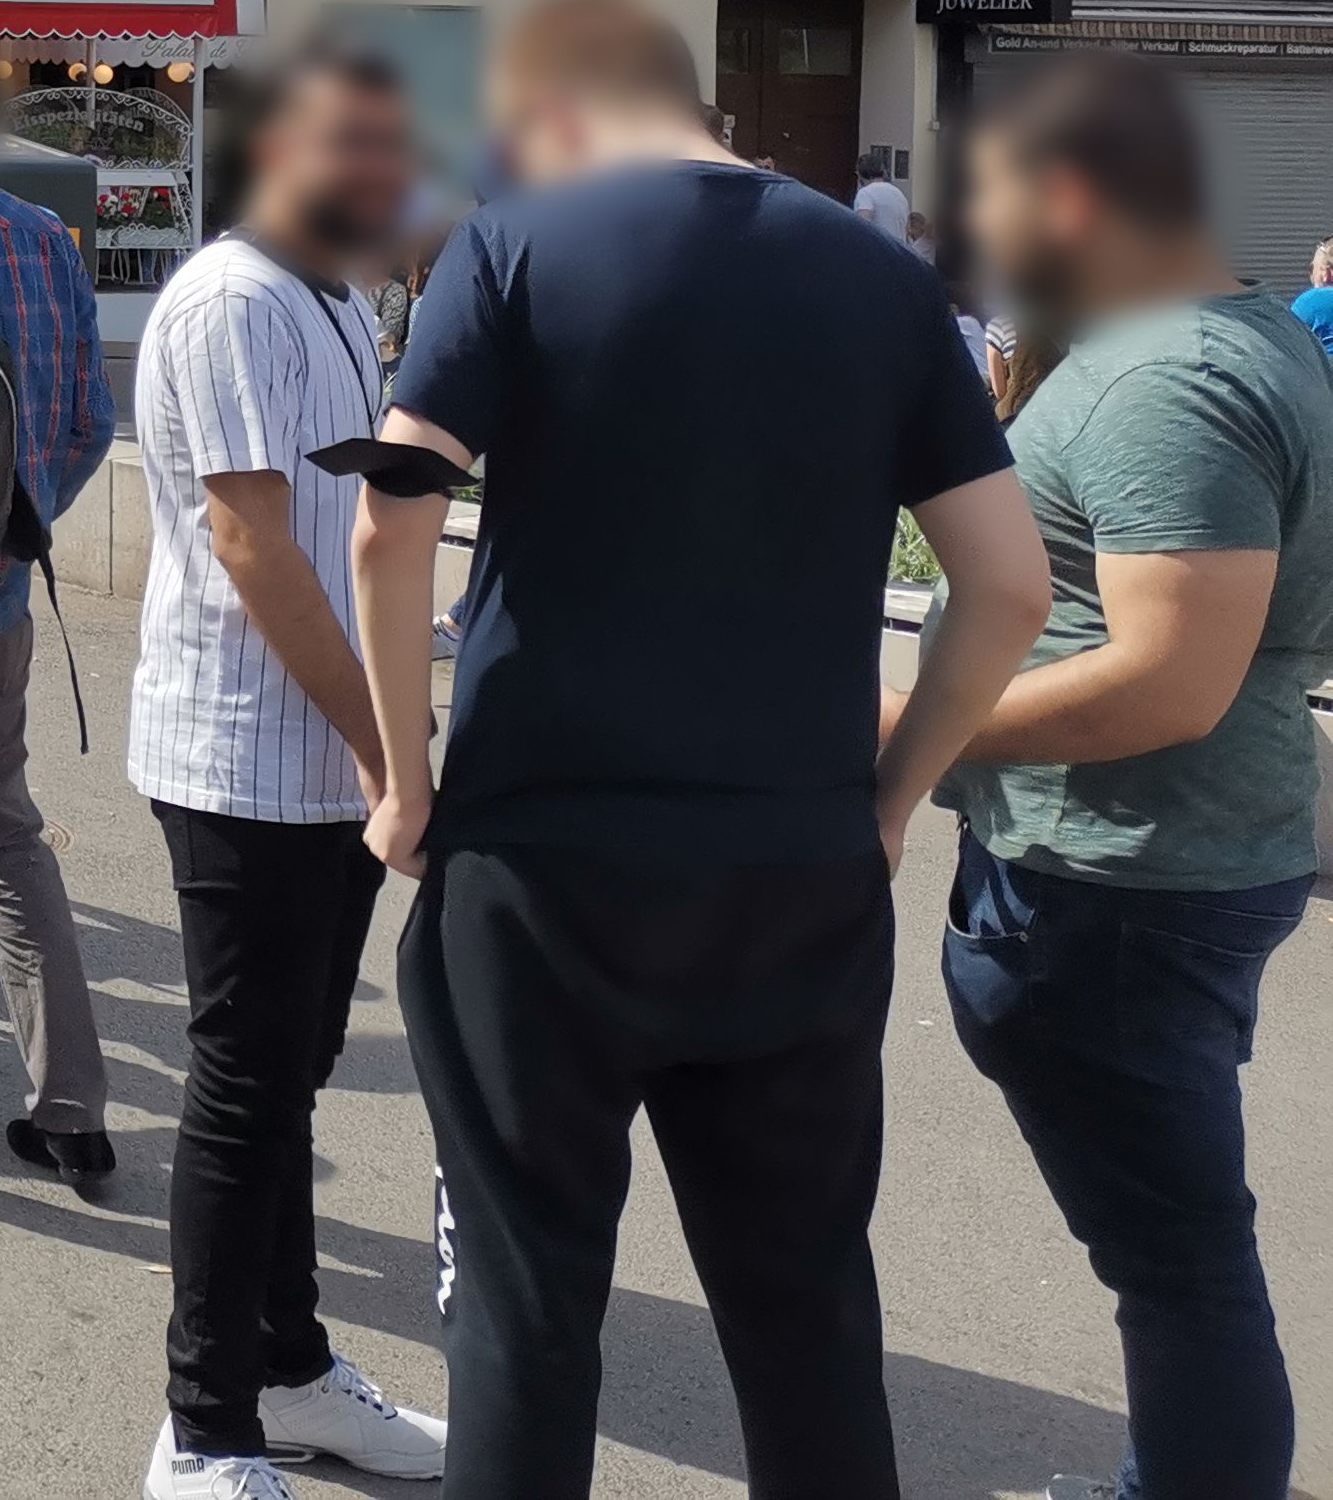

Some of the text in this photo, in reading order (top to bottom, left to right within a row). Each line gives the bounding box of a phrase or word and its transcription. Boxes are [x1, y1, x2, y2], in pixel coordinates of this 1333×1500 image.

[141, 39, 195, 59] Palai
[996, 36, 1019, 49] Gold
[1143, 40, 1179, 52] Verkauf
[1188, 42, 1278, 56] Schmuckreparatur
[171, 1457, 205, 1476] PUMA
